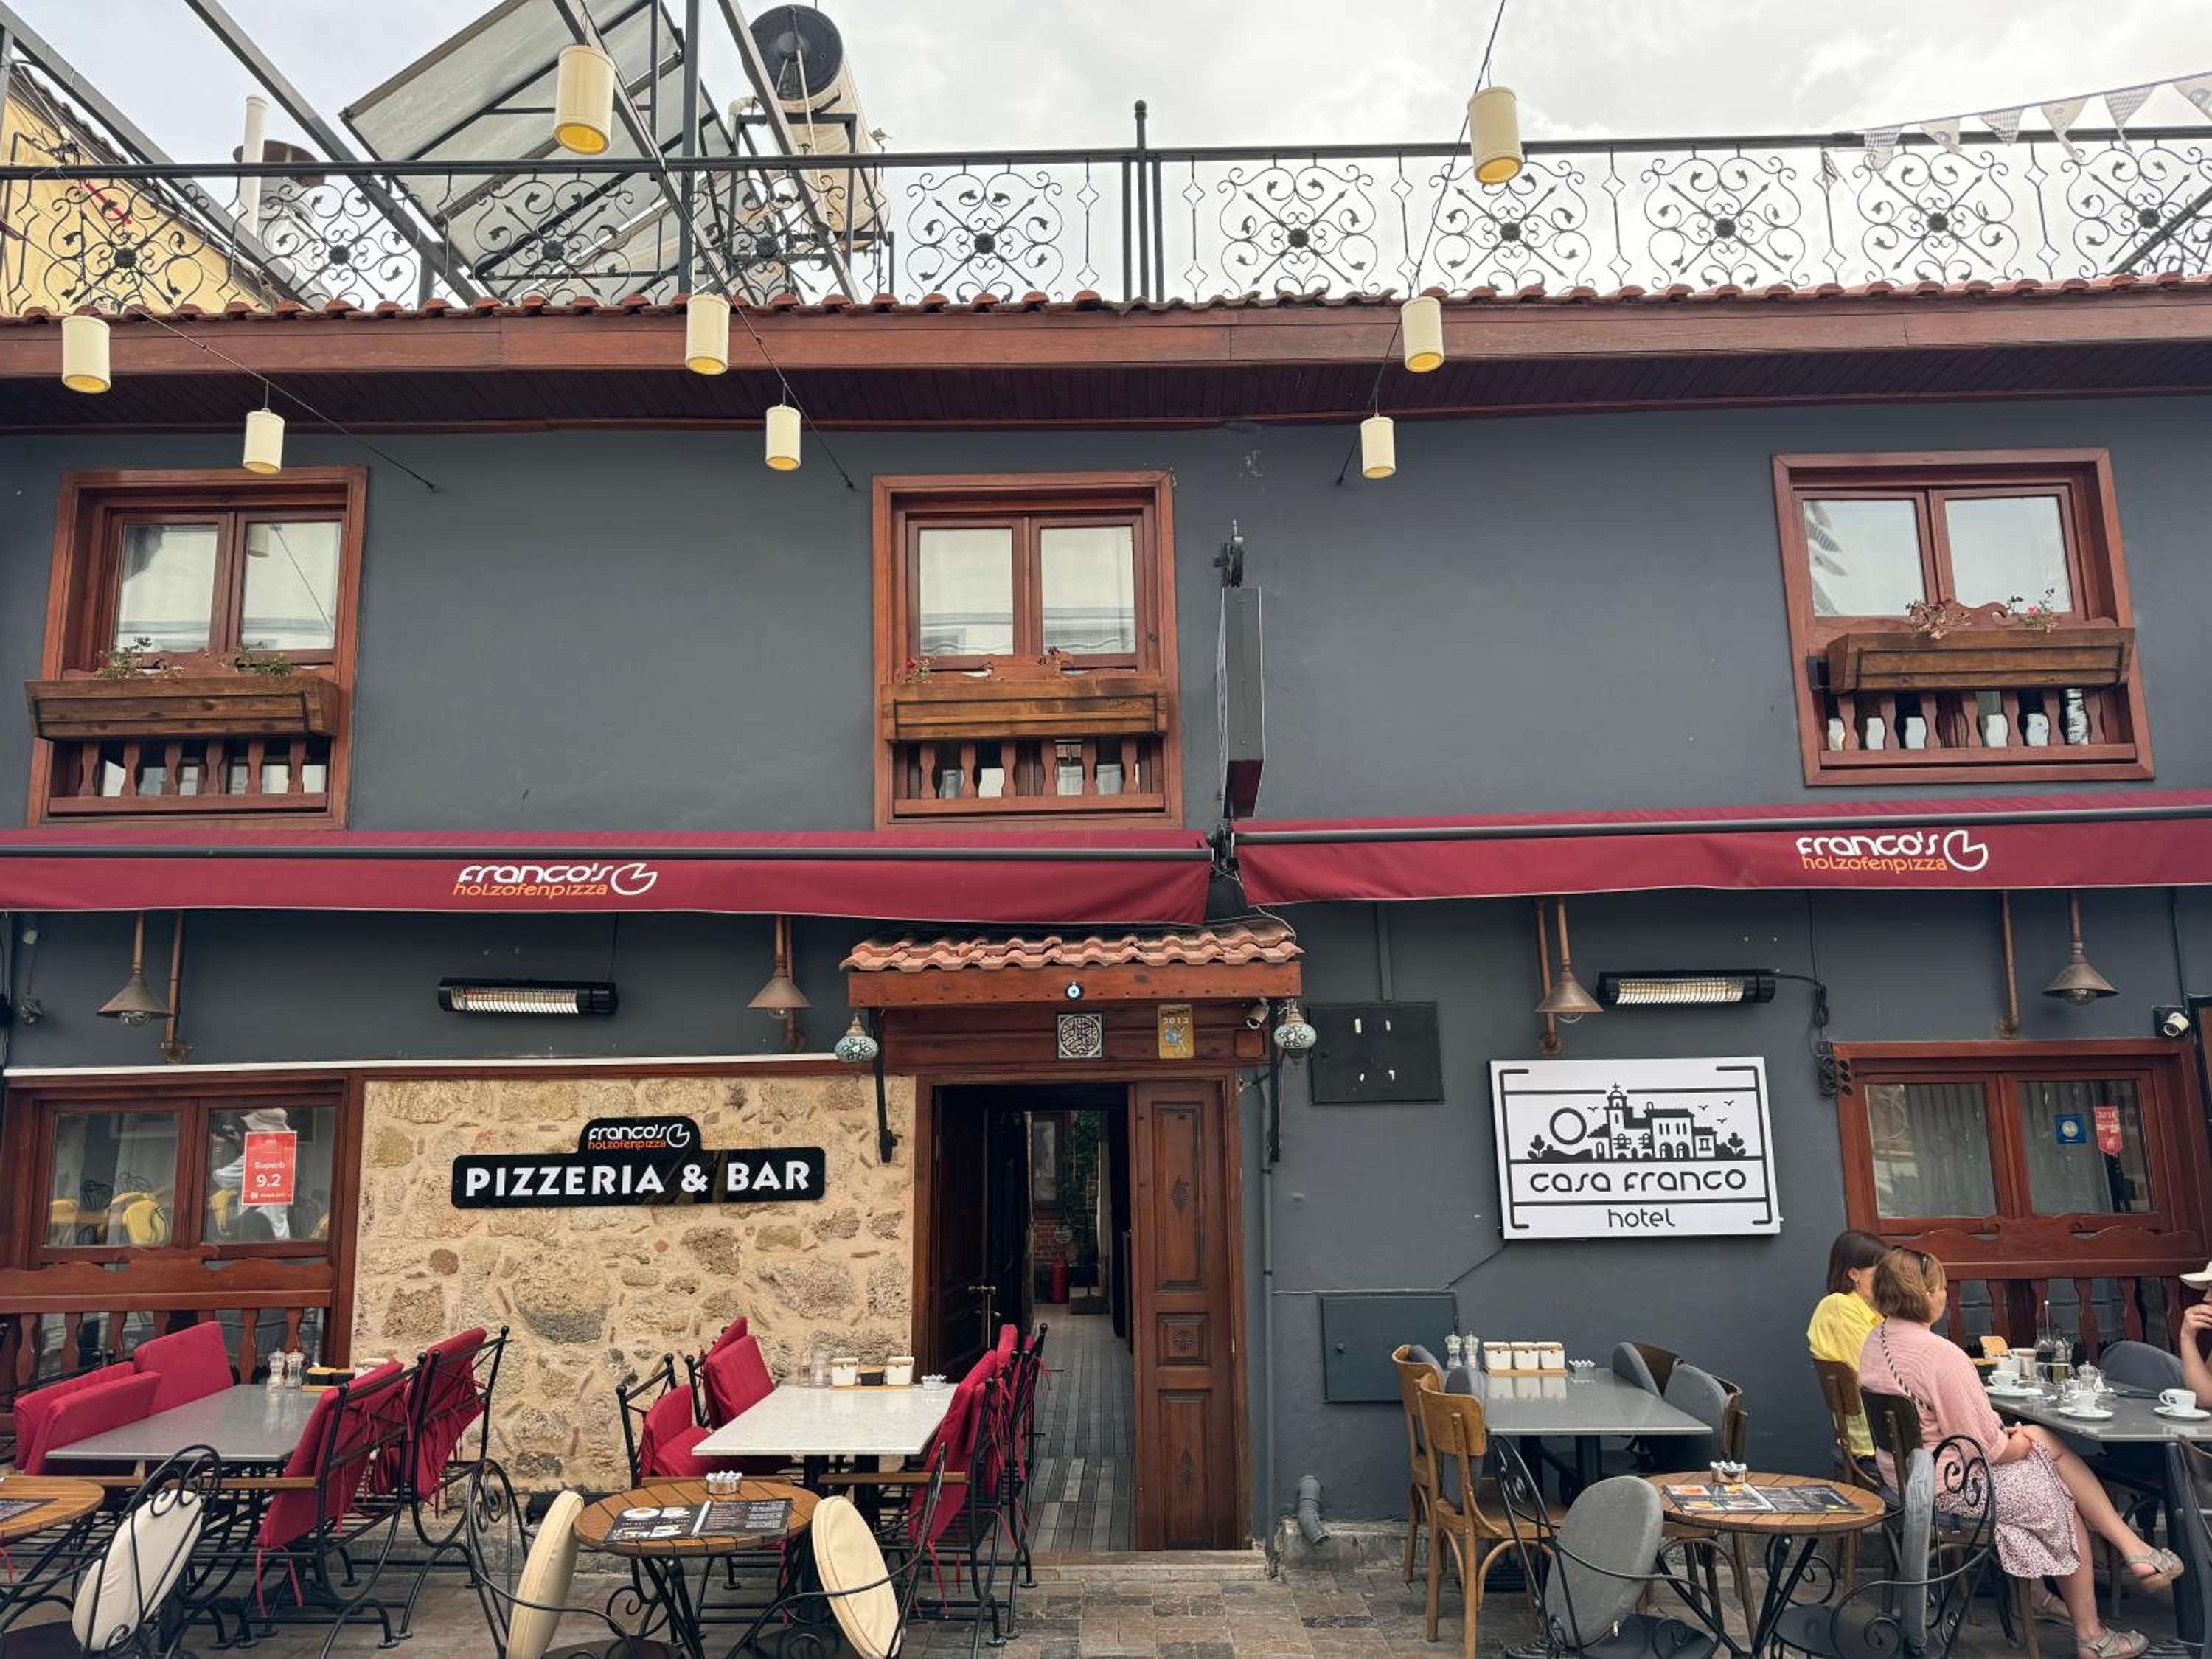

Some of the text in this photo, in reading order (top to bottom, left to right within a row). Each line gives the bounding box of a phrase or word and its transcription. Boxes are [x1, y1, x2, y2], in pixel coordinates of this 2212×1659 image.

[1795, 831, 1938, 856] franco's
[457, 863, 614, 883] franco's
[1801, 855, 1947, 874] holzofenpizza
[453, 882, 608, 899] holzofenpizza
[588, 1124, 667, 1141] franco's
[588, 1139, 667, 1150] holzofenpizza
[257, 1174, 282, 1188] 9.2
[466, 1161, 810, 1197] PIZZERIA & BAR
[1530, 1169, 1747, 1193] casa franco
[1608, 1208, 1675, 1228] hotel
